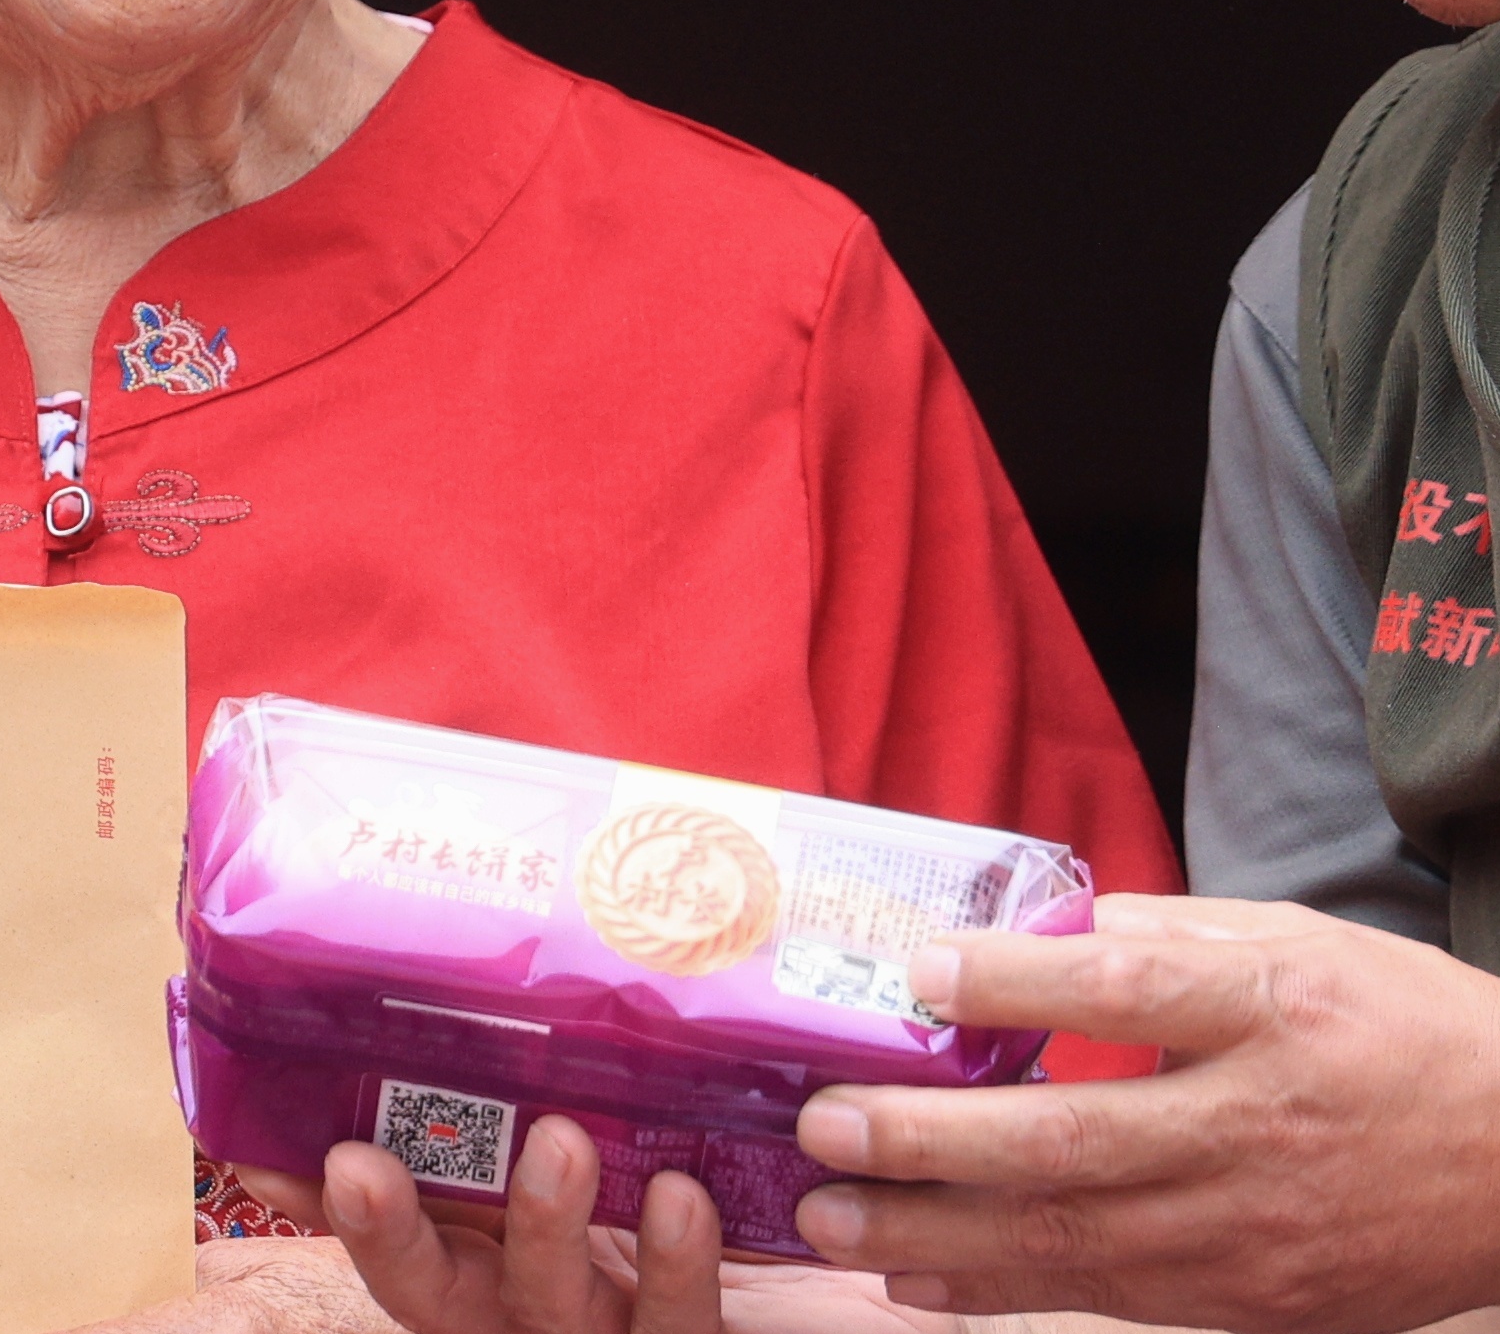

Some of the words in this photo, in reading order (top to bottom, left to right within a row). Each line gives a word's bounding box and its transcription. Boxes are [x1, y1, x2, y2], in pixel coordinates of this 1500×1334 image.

[338, 818, 558, 893] 卢村长饼家
